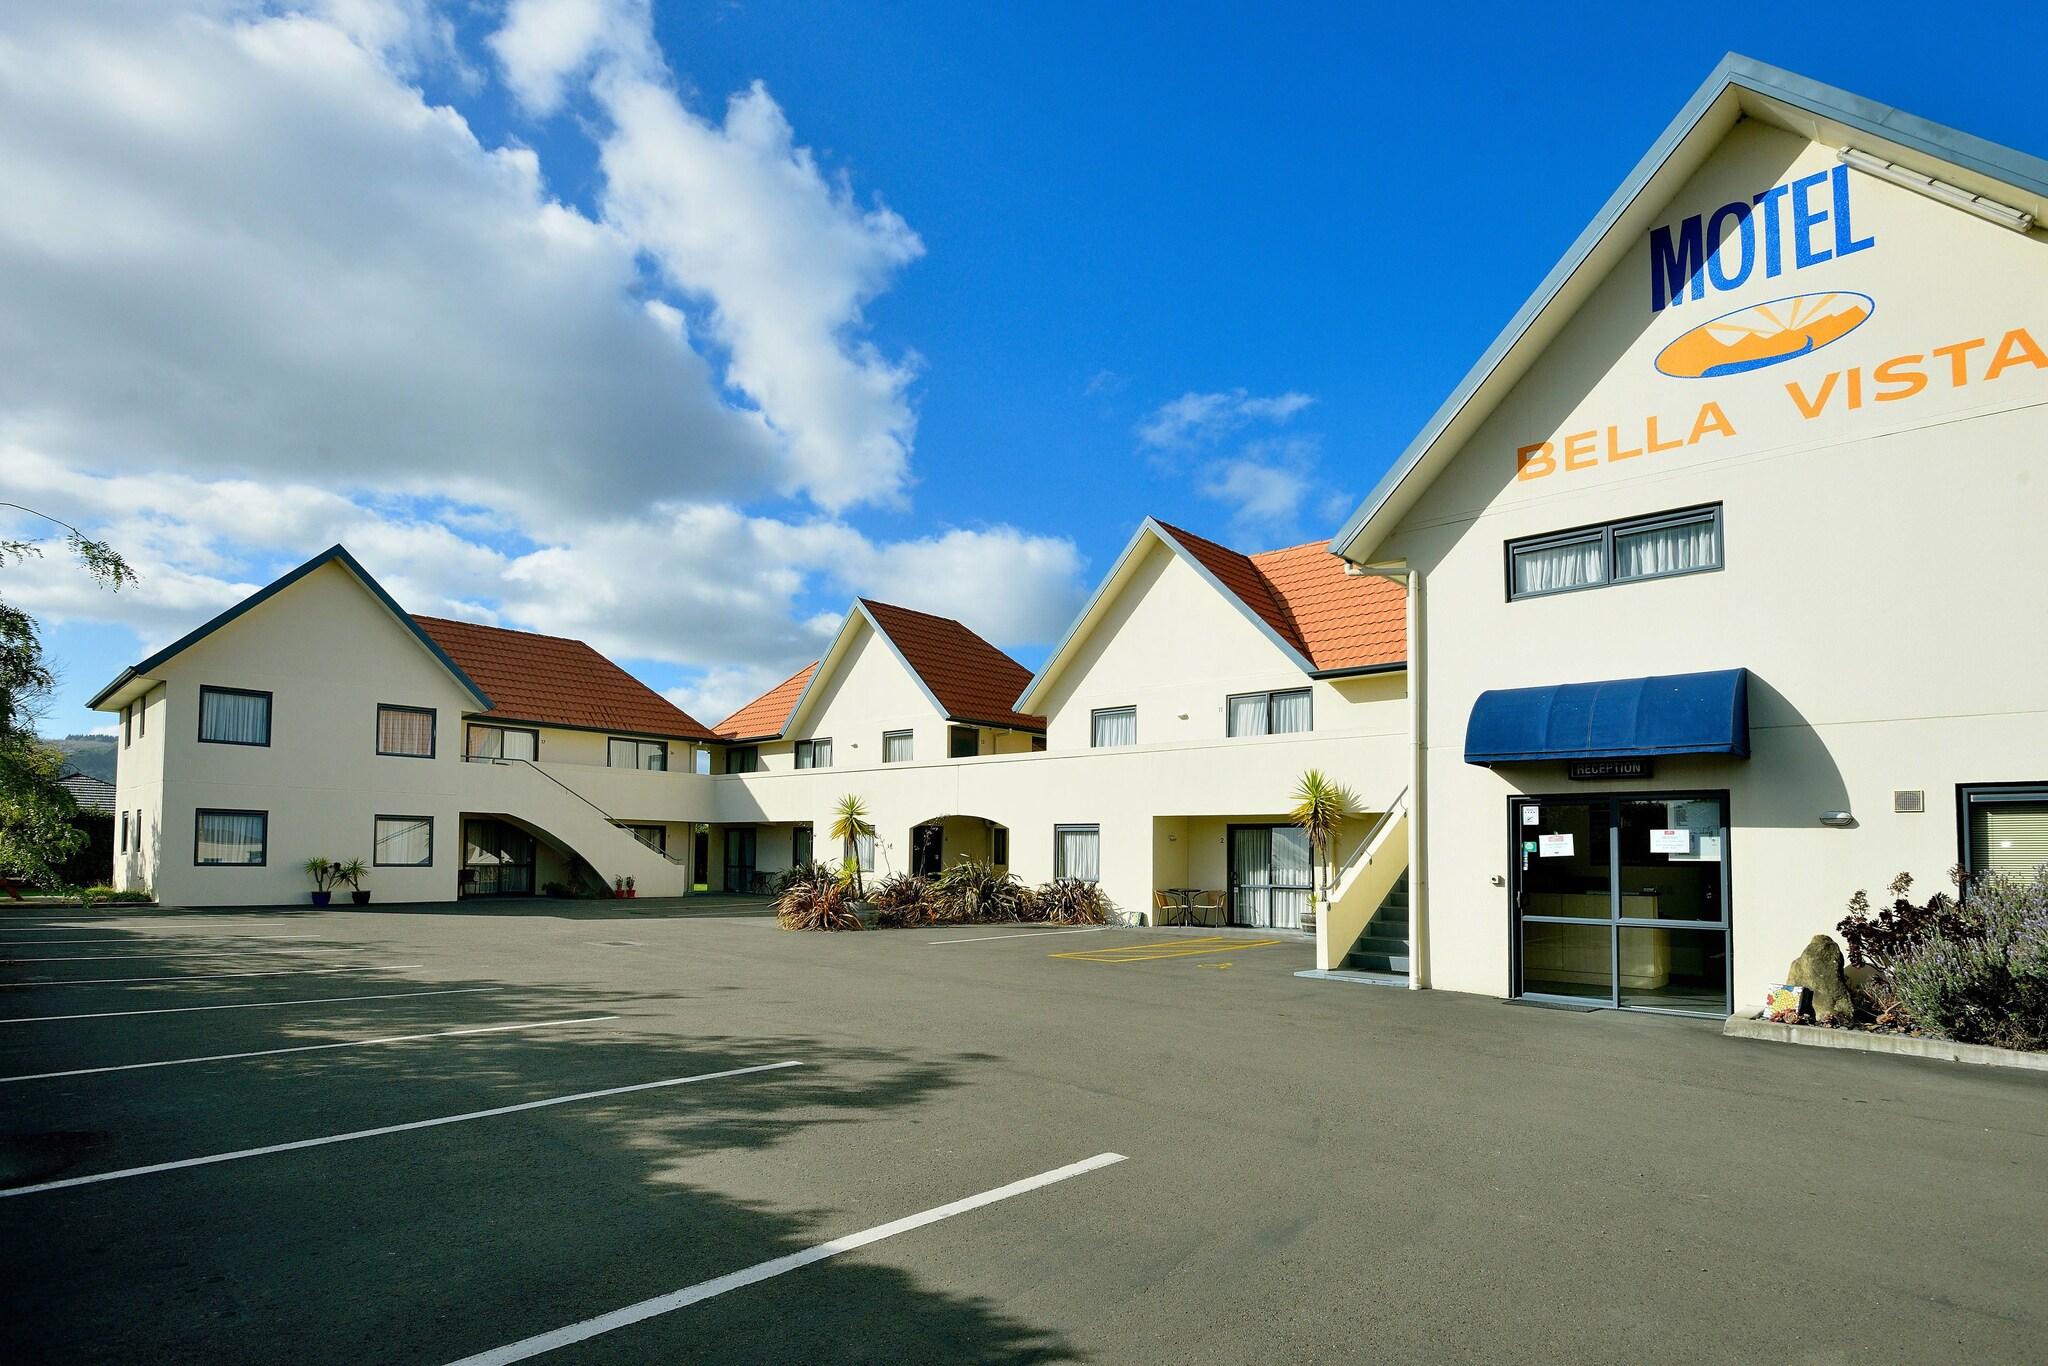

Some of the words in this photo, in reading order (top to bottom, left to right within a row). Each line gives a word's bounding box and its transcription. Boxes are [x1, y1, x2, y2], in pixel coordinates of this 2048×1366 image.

[1650, 163, 1875, 313] MOTEL
[1517, 402, 1737, 482] BELLA
[1786, 327, 2048, 419] VISTA
[1576, 762, 1641, 775] RECEPTION
